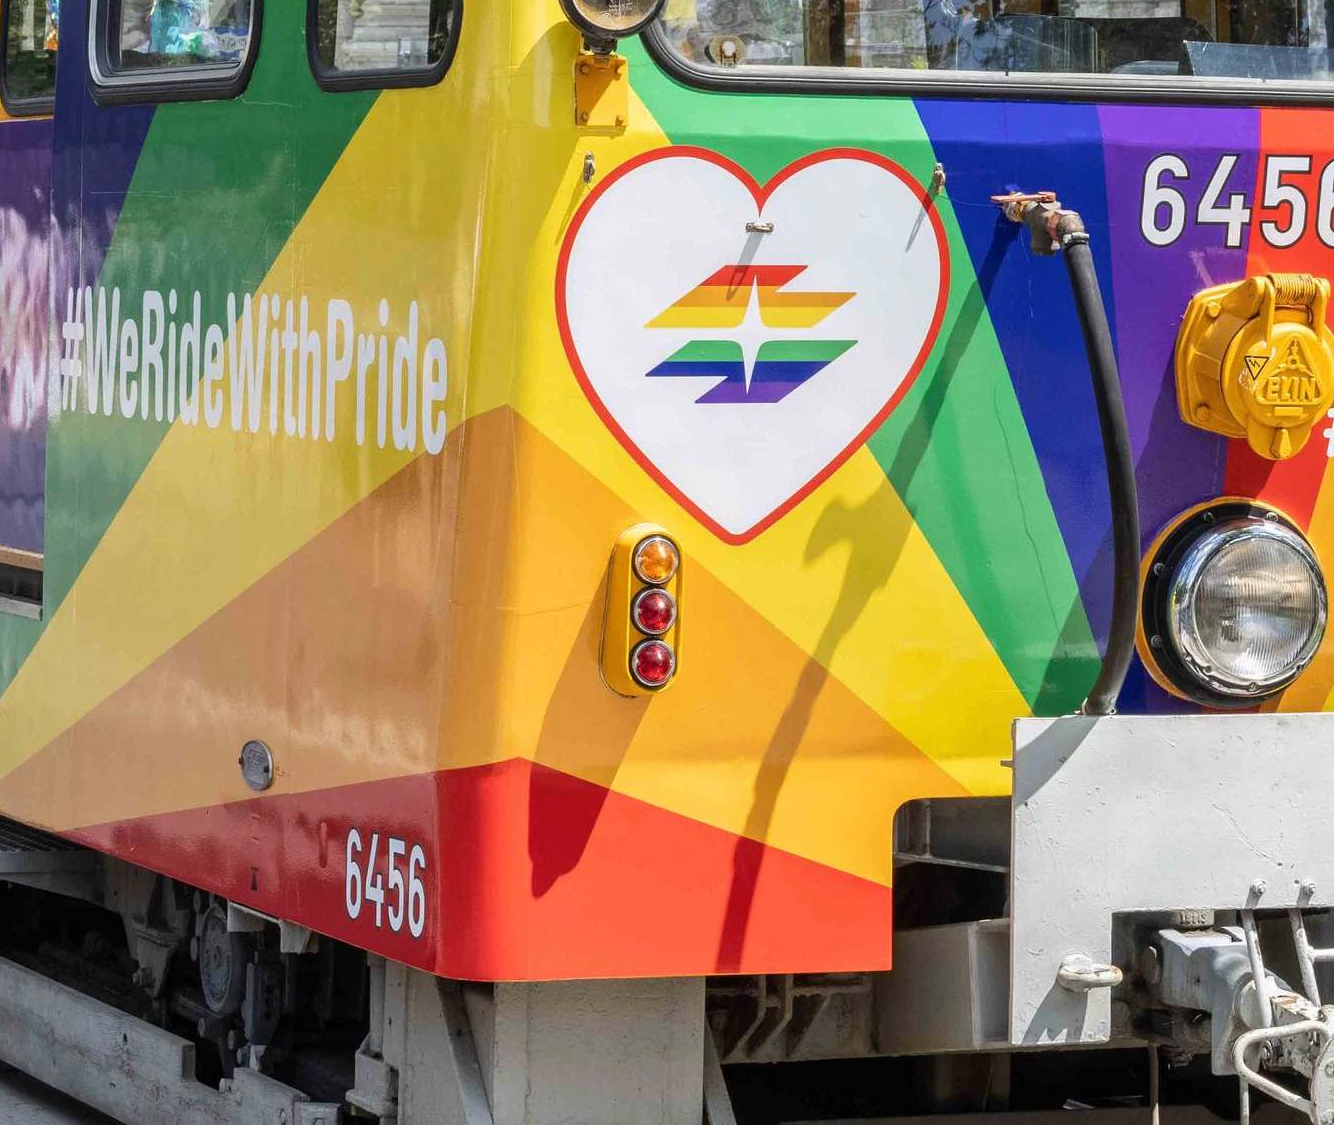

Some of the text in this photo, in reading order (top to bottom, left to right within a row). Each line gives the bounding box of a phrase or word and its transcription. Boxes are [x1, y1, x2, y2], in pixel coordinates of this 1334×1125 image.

[60, 285, 448, 456] #WeRideWithPride
[1267, 376, 1317, 402] ELIN
[346, 826, 426, 939] 6456
